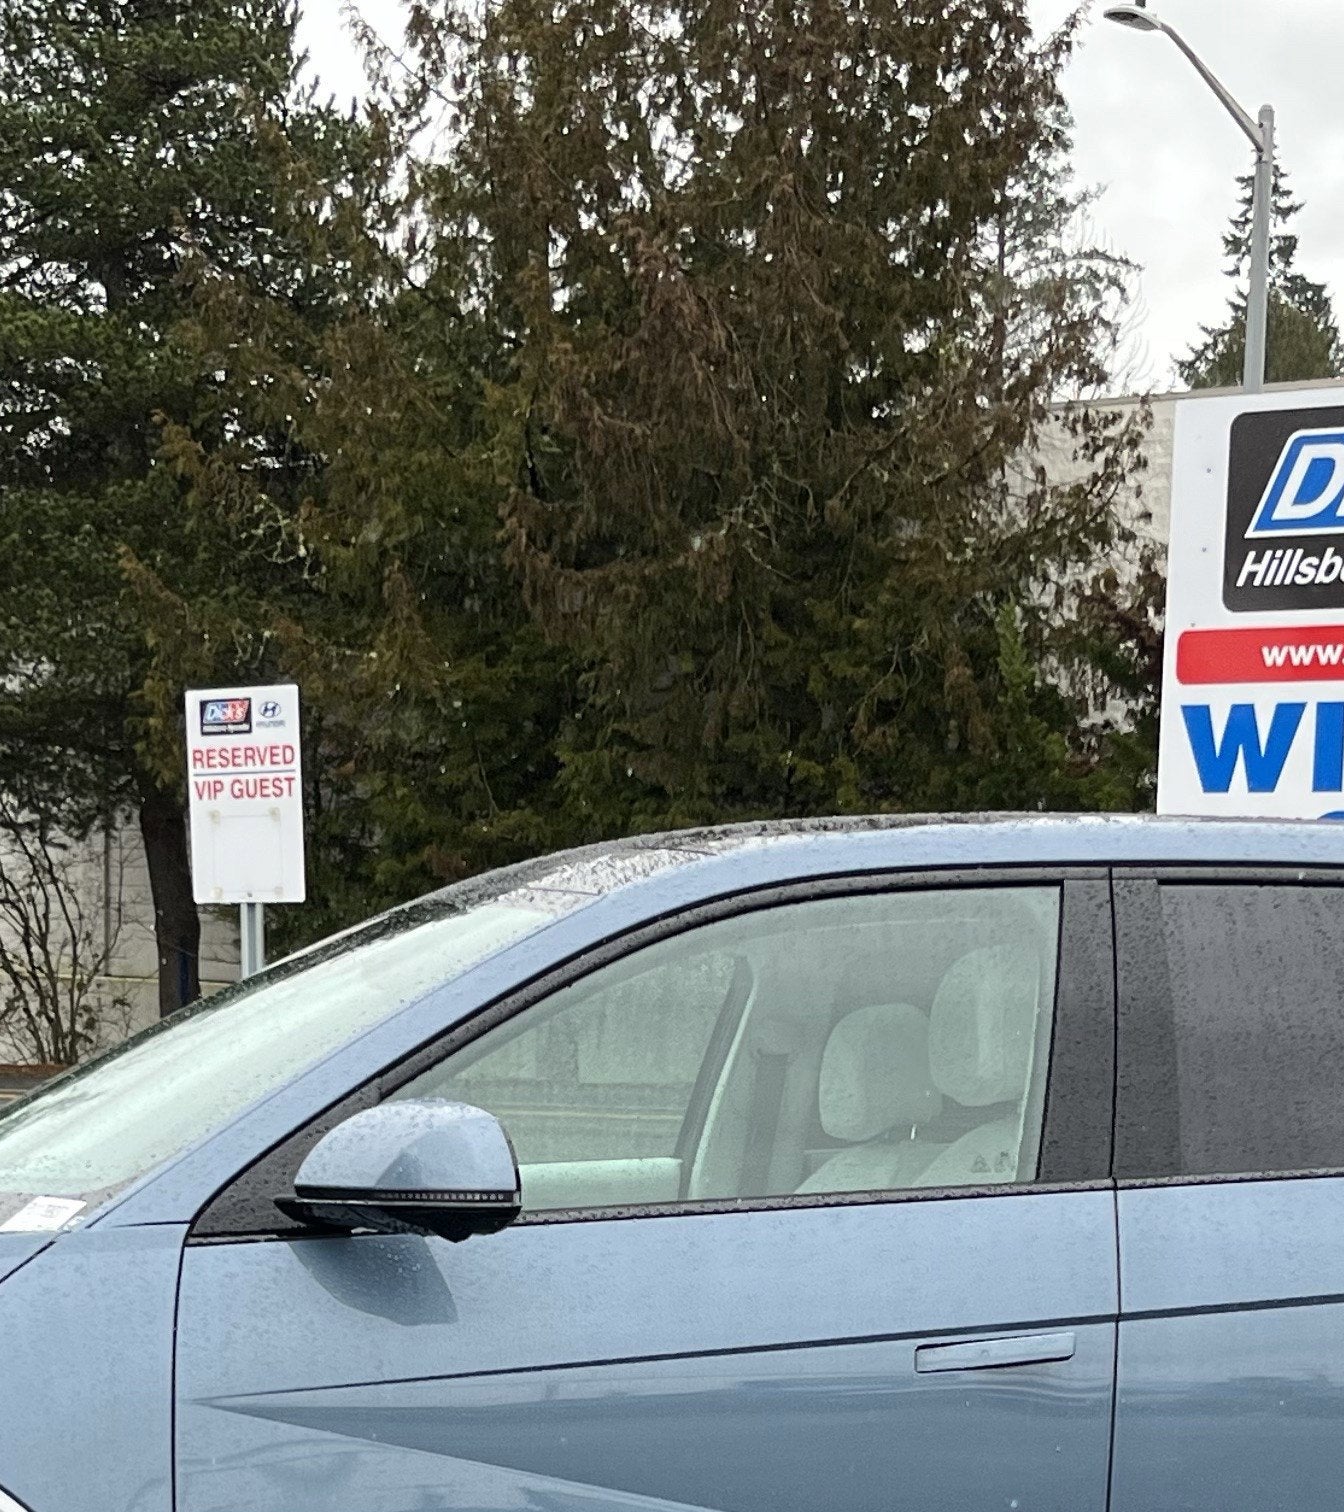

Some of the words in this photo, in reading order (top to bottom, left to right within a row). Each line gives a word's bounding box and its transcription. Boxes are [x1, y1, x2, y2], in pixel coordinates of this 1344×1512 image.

[194, 746, 294, 768] RESERVED
[195, 780, 224, 800] VIP
[232, 778, 294, 799] GUEST
